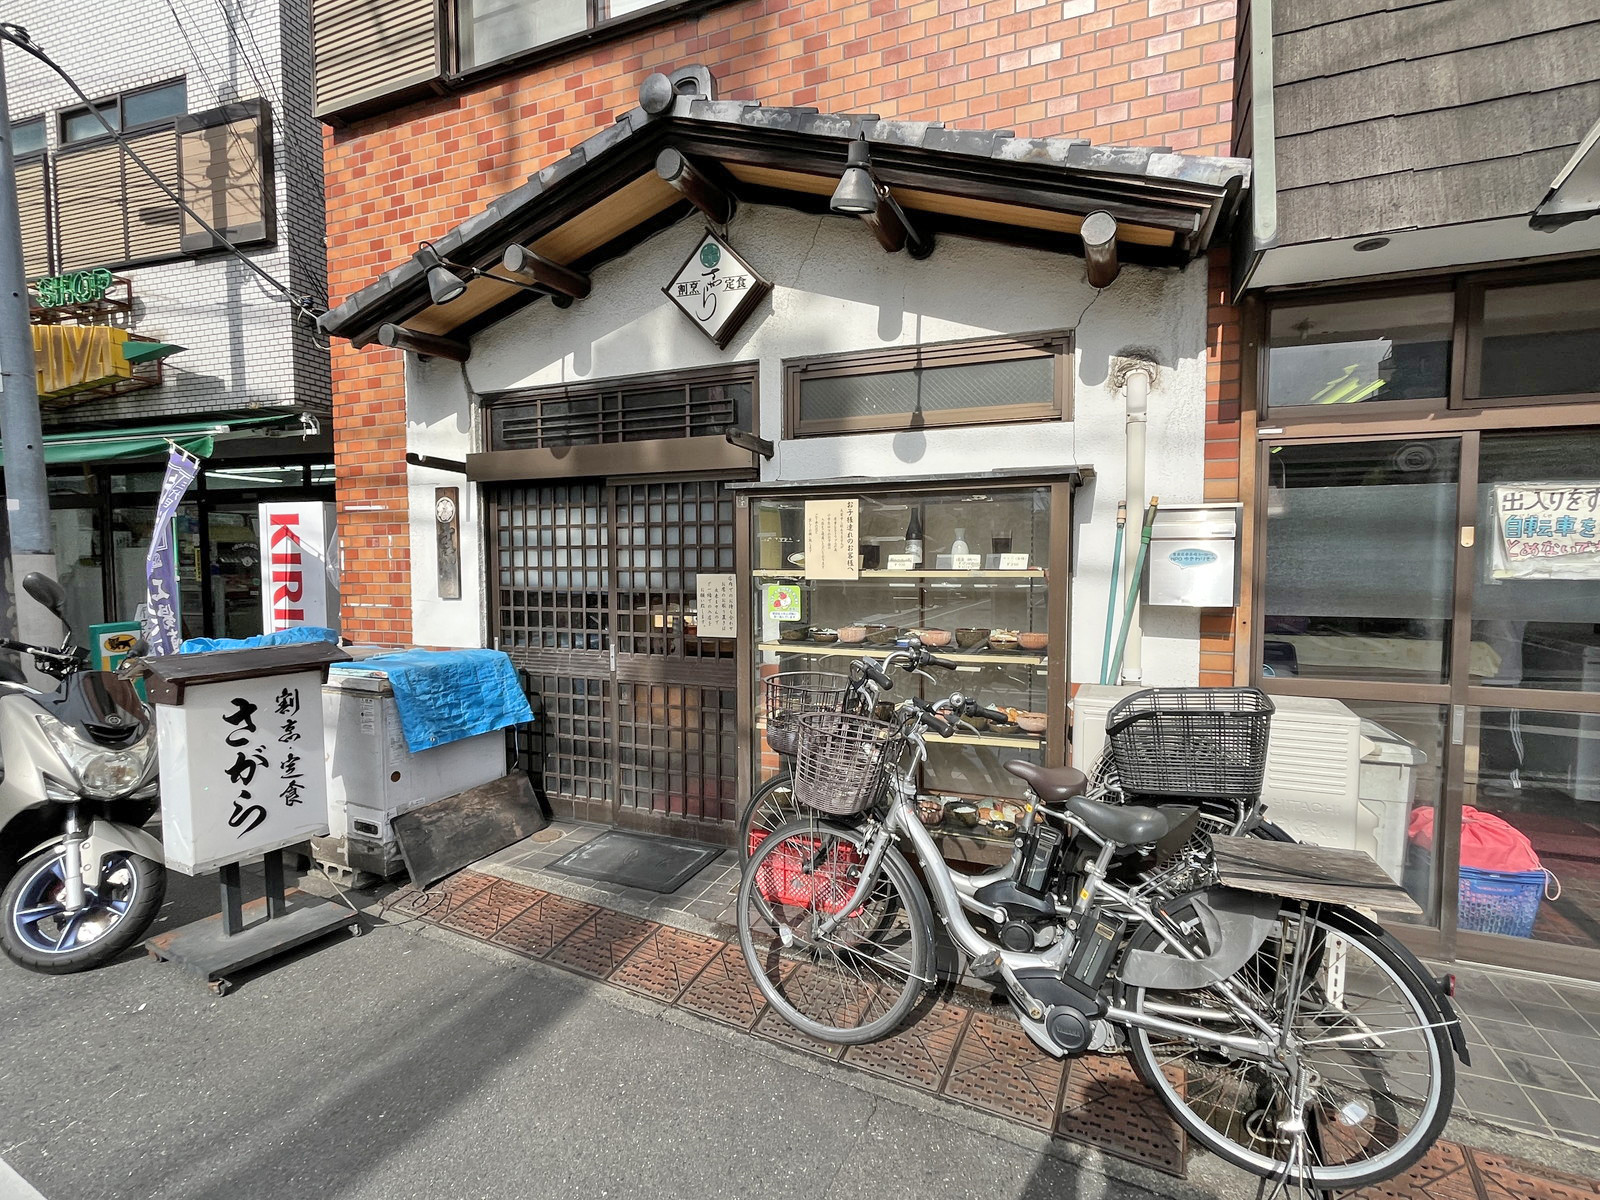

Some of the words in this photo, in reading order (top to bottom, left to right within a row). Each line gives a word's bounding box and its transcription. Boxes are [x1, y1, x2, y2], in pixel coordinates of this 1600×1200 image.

[35, 267, 112, 308] SHOP
[677, 282, 700, 297] 割烹
[695, 268, 723, 322] さがら
[724, 277, 747, 291] 定食
[846, 501, 854, 572] お子様連れのお客様へ
[1505, 514, 1597, 538] 自転車を
[1507, 539, 1600, 557] とめないで
[270, 513, 304, 632] KIRI
[222, 697, 270, 840] さがら
